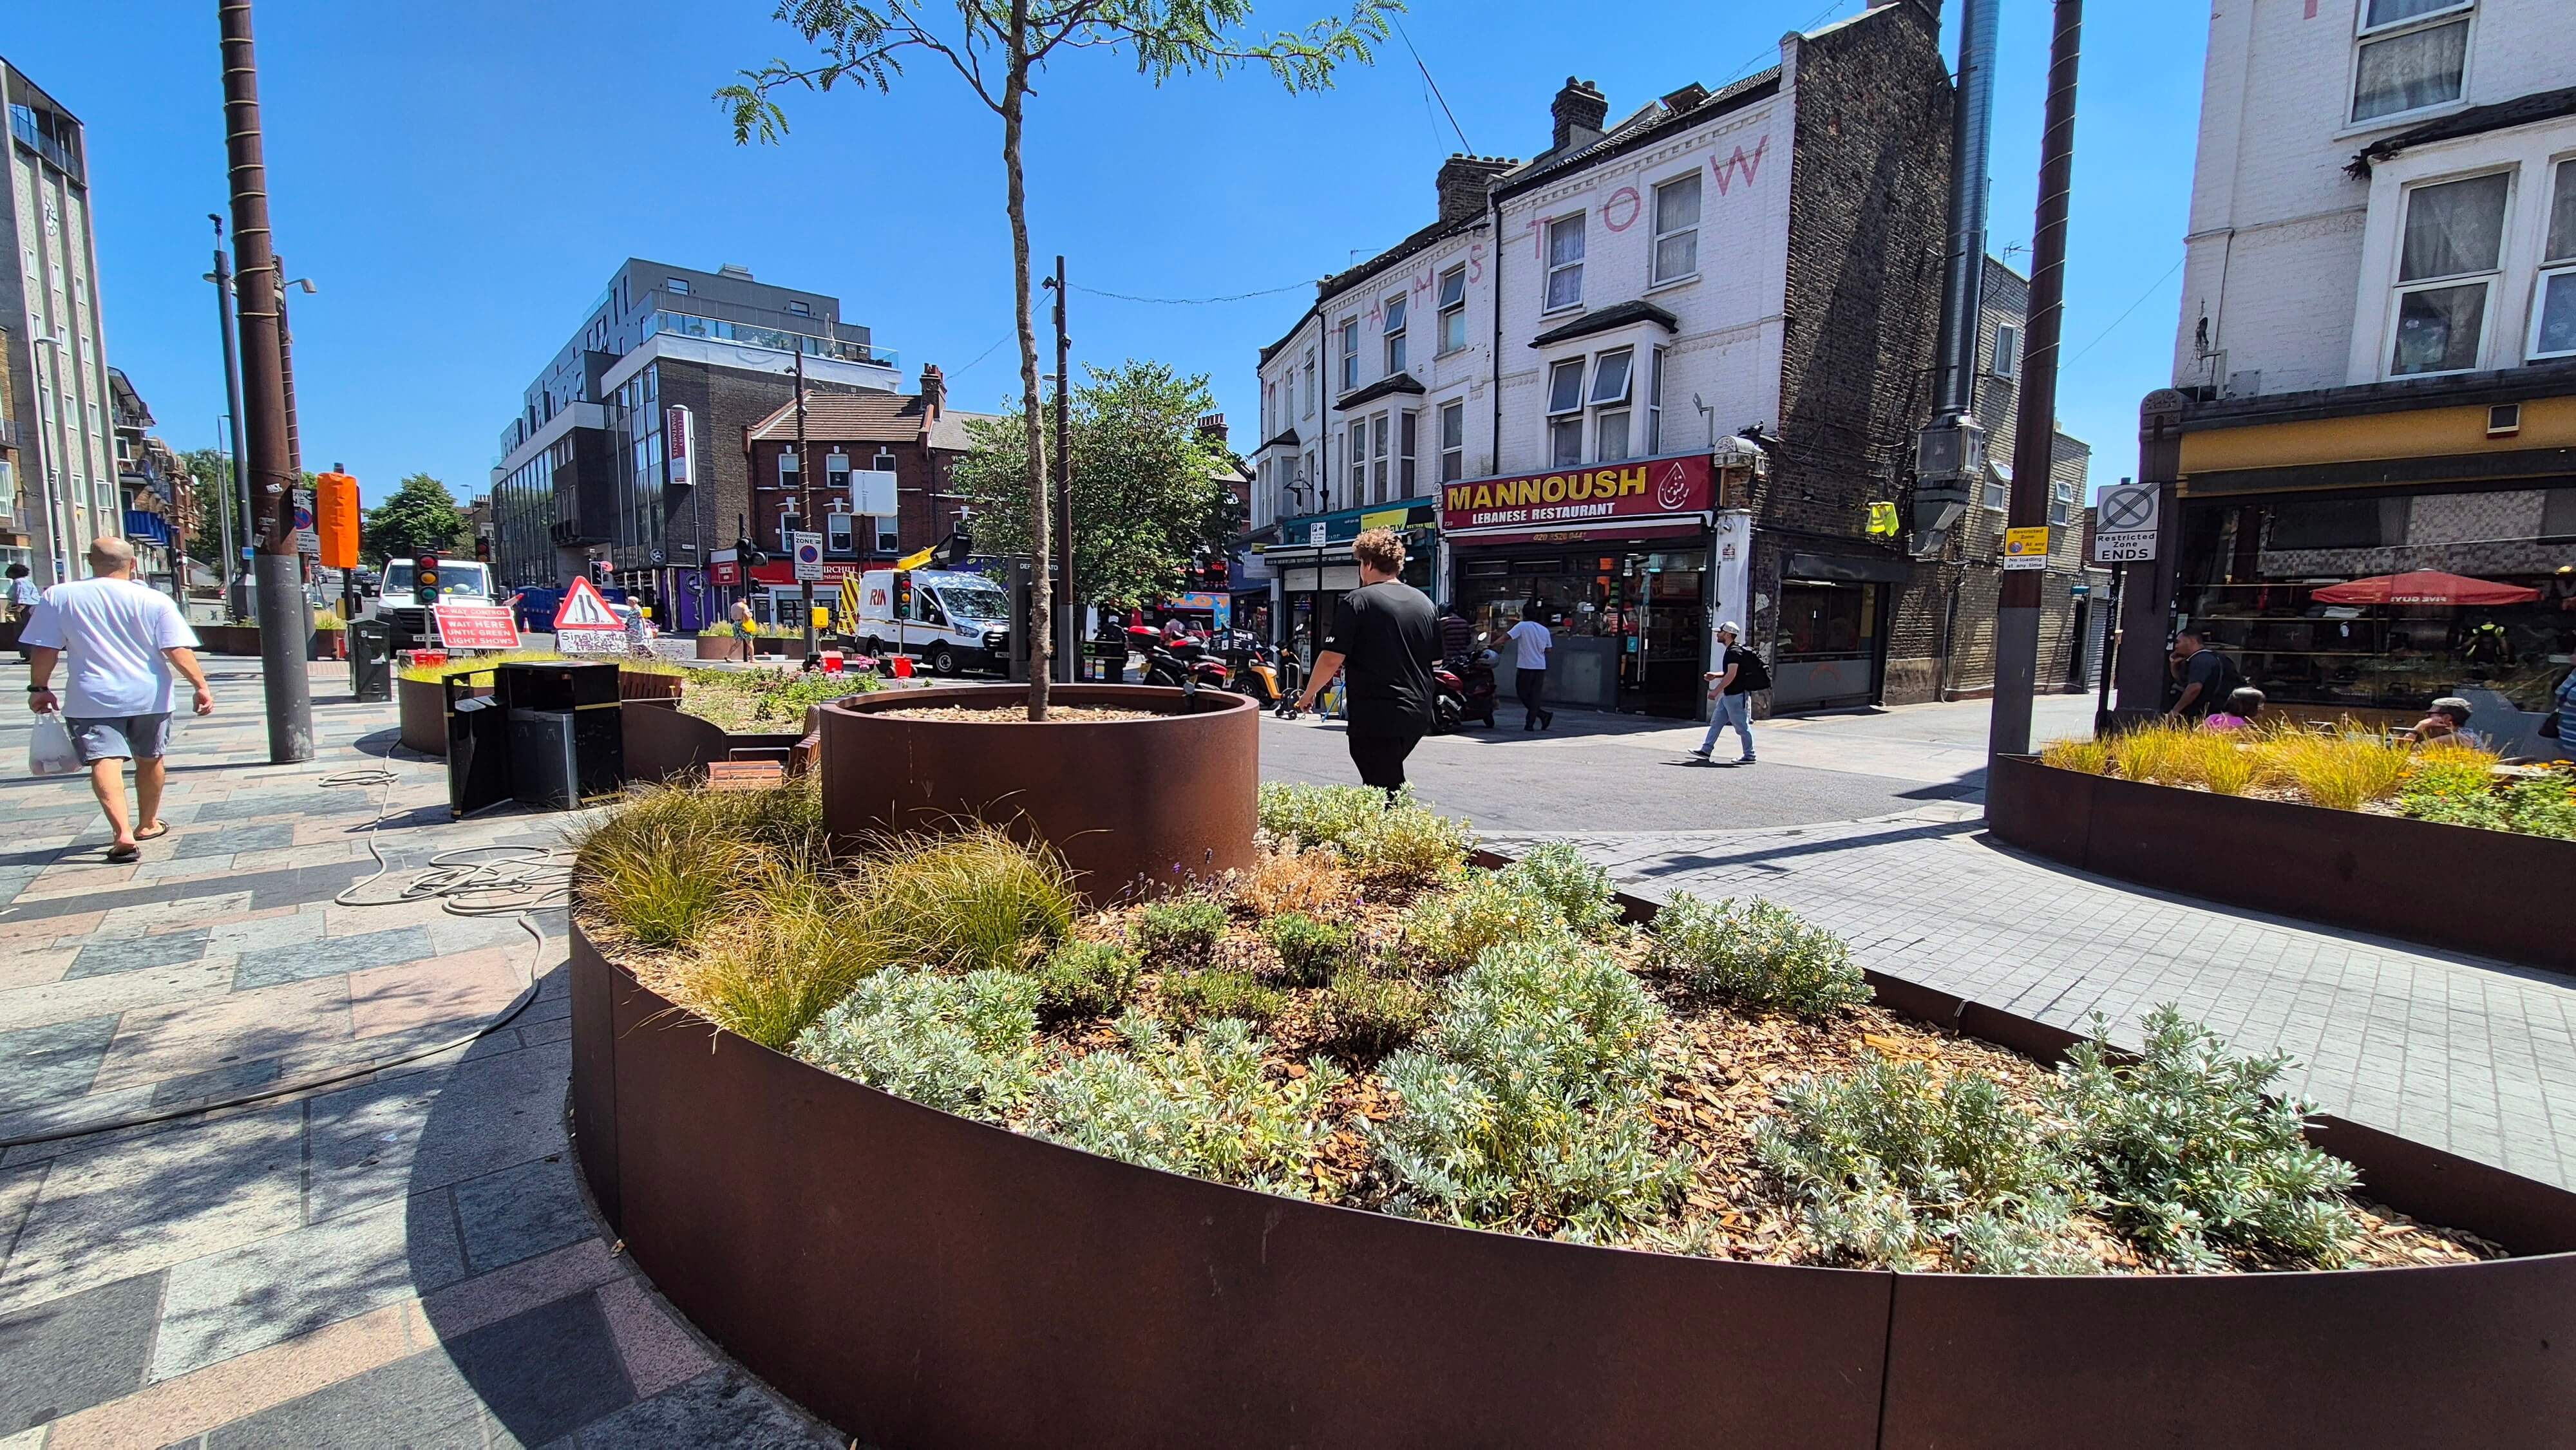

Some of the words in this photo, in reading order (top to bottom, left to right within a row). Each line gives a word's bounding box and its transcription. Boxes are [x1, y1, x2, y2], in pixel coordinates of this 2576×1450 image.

[1448, 467, 1647, 511] MANNOUSH
[1472, 509, 1526, 524] LEBANESE
[1532, 502, 1615, 520] RESTAURANT
[2102, 549, 2148, 560] ENDS
